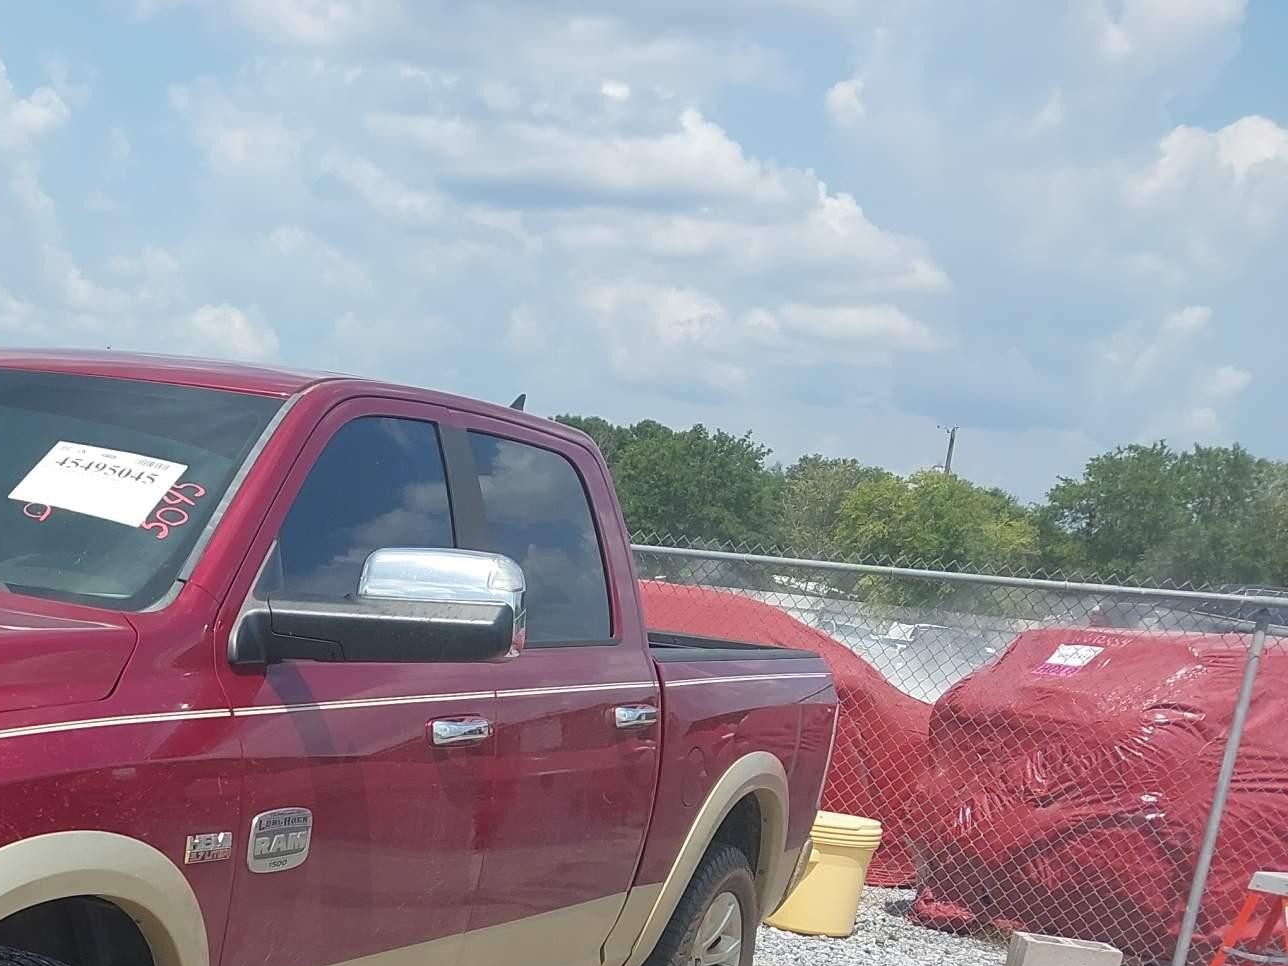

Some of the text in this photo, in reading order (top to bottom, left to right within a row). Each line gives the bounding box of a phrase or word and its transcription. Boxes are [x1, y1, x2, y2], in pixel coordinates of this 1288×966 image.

[55, 456, 159, 484] 45495045
[255, 832, 308, 854] RAM
[269, 859, 288, 868] 1500
